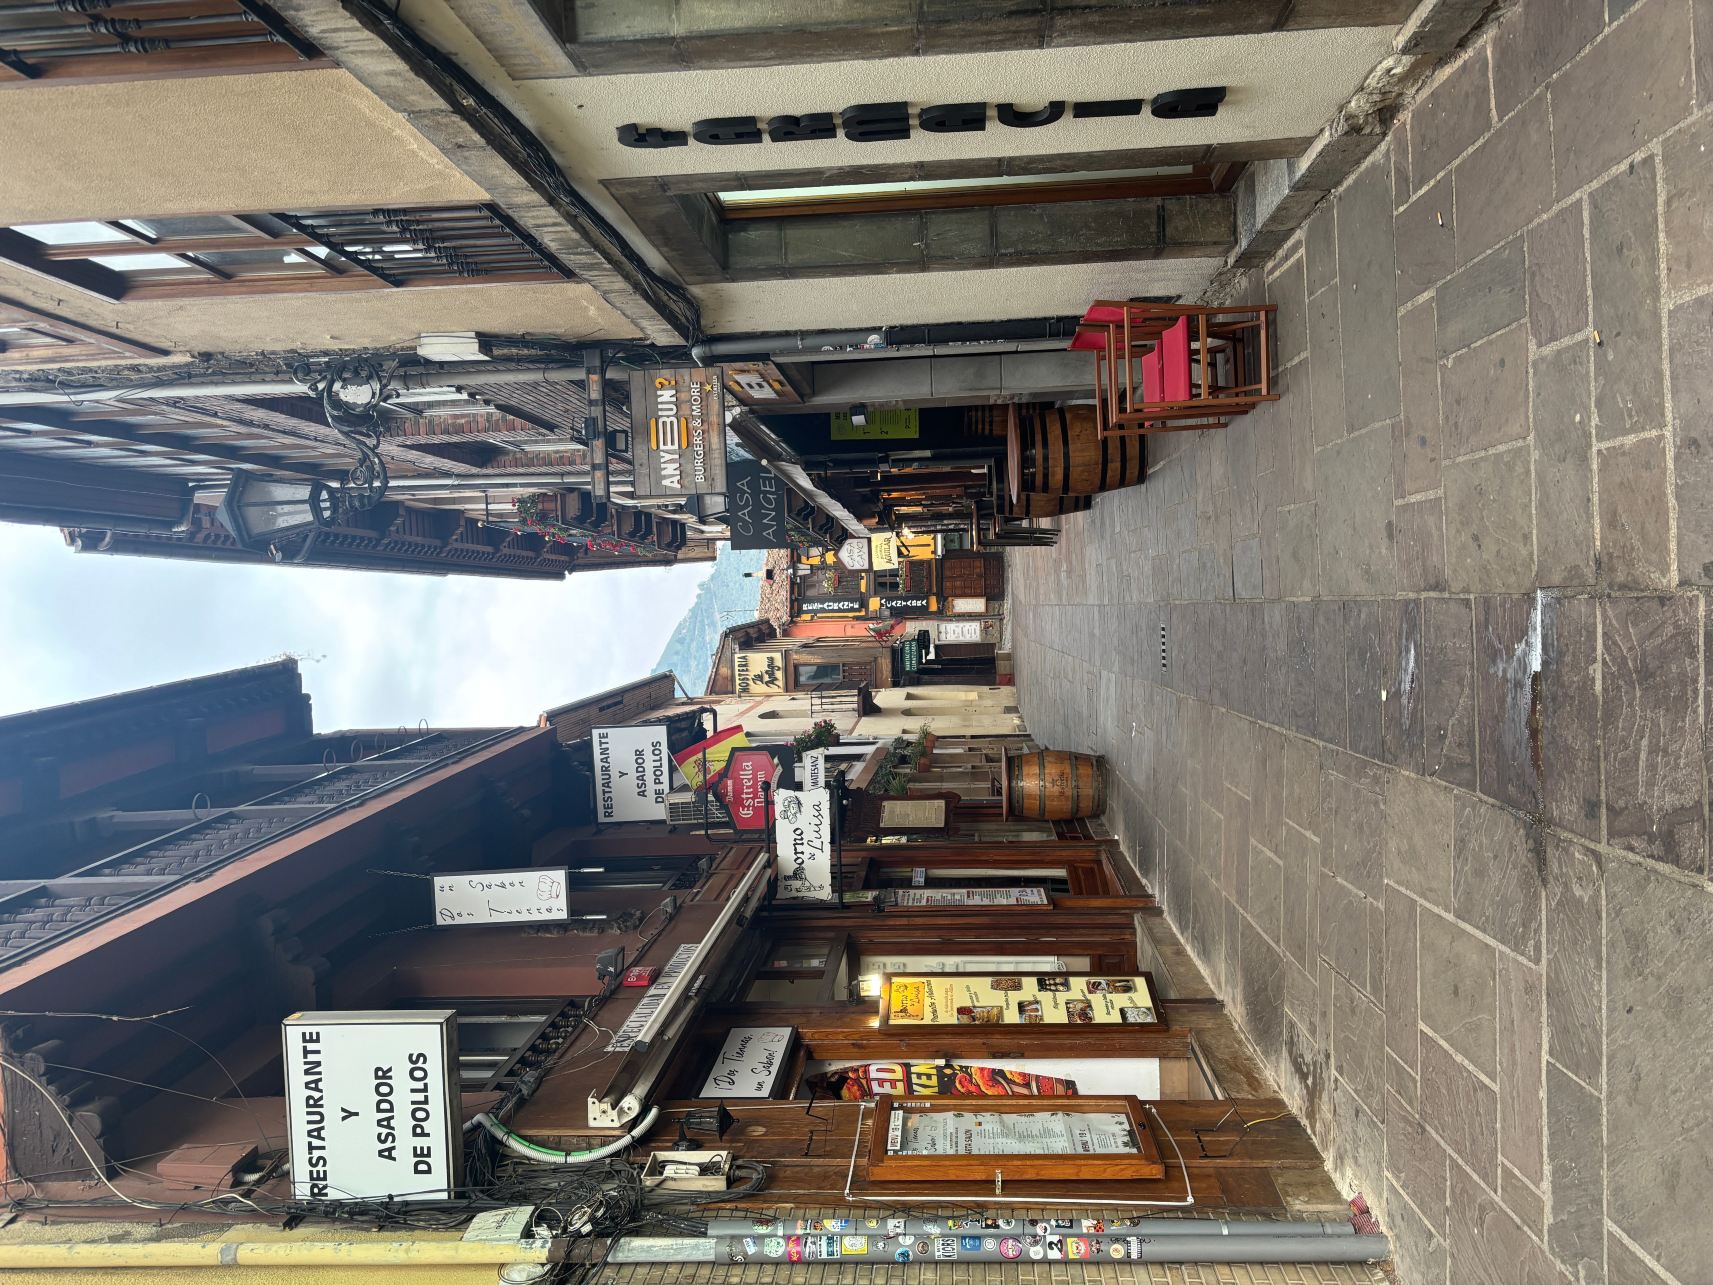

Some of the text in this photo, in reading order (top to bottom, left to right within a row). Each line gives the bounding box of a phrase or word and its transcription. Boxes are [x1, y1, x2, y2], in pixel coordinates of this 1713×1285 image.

[614, 86, 1227, 149] FARMACIA
[690, 381, 705, 482] BURGERS & MORE
[736, 476, 753, 536] CASA
[760, 470, 777, 542] ANGEL
[847, 543, 855, 567] CASA
[884, 536, 894, 565] AGUILAR
[802, 601, 859, 610] RESTAURANTE
[737, 655, 749, 693] HOSTERIA
[764, 656, 781, 689] Antigua
[599, 732, 613, 818] RESTAURANTE
[635, 749, 647, 798] ASADOR
[652, 741, 664, 804] DE POLLOS
[738, 761, 754, 818] Estrella
[755, 771, 766, 807] Dam
[810, 755, 819, 787] MATESANZ
[806, 801, 824, 860] de Luisa
[751, 1048, 777, 1076] Sabor!
[302, 1031, 328, 1198] RESTAURANTE
[341, 1107, 359, 1122] Y
[374, 1066, 397, 1162] ASADOR
[408, 1052, 432, 1175] DE POLLOS
